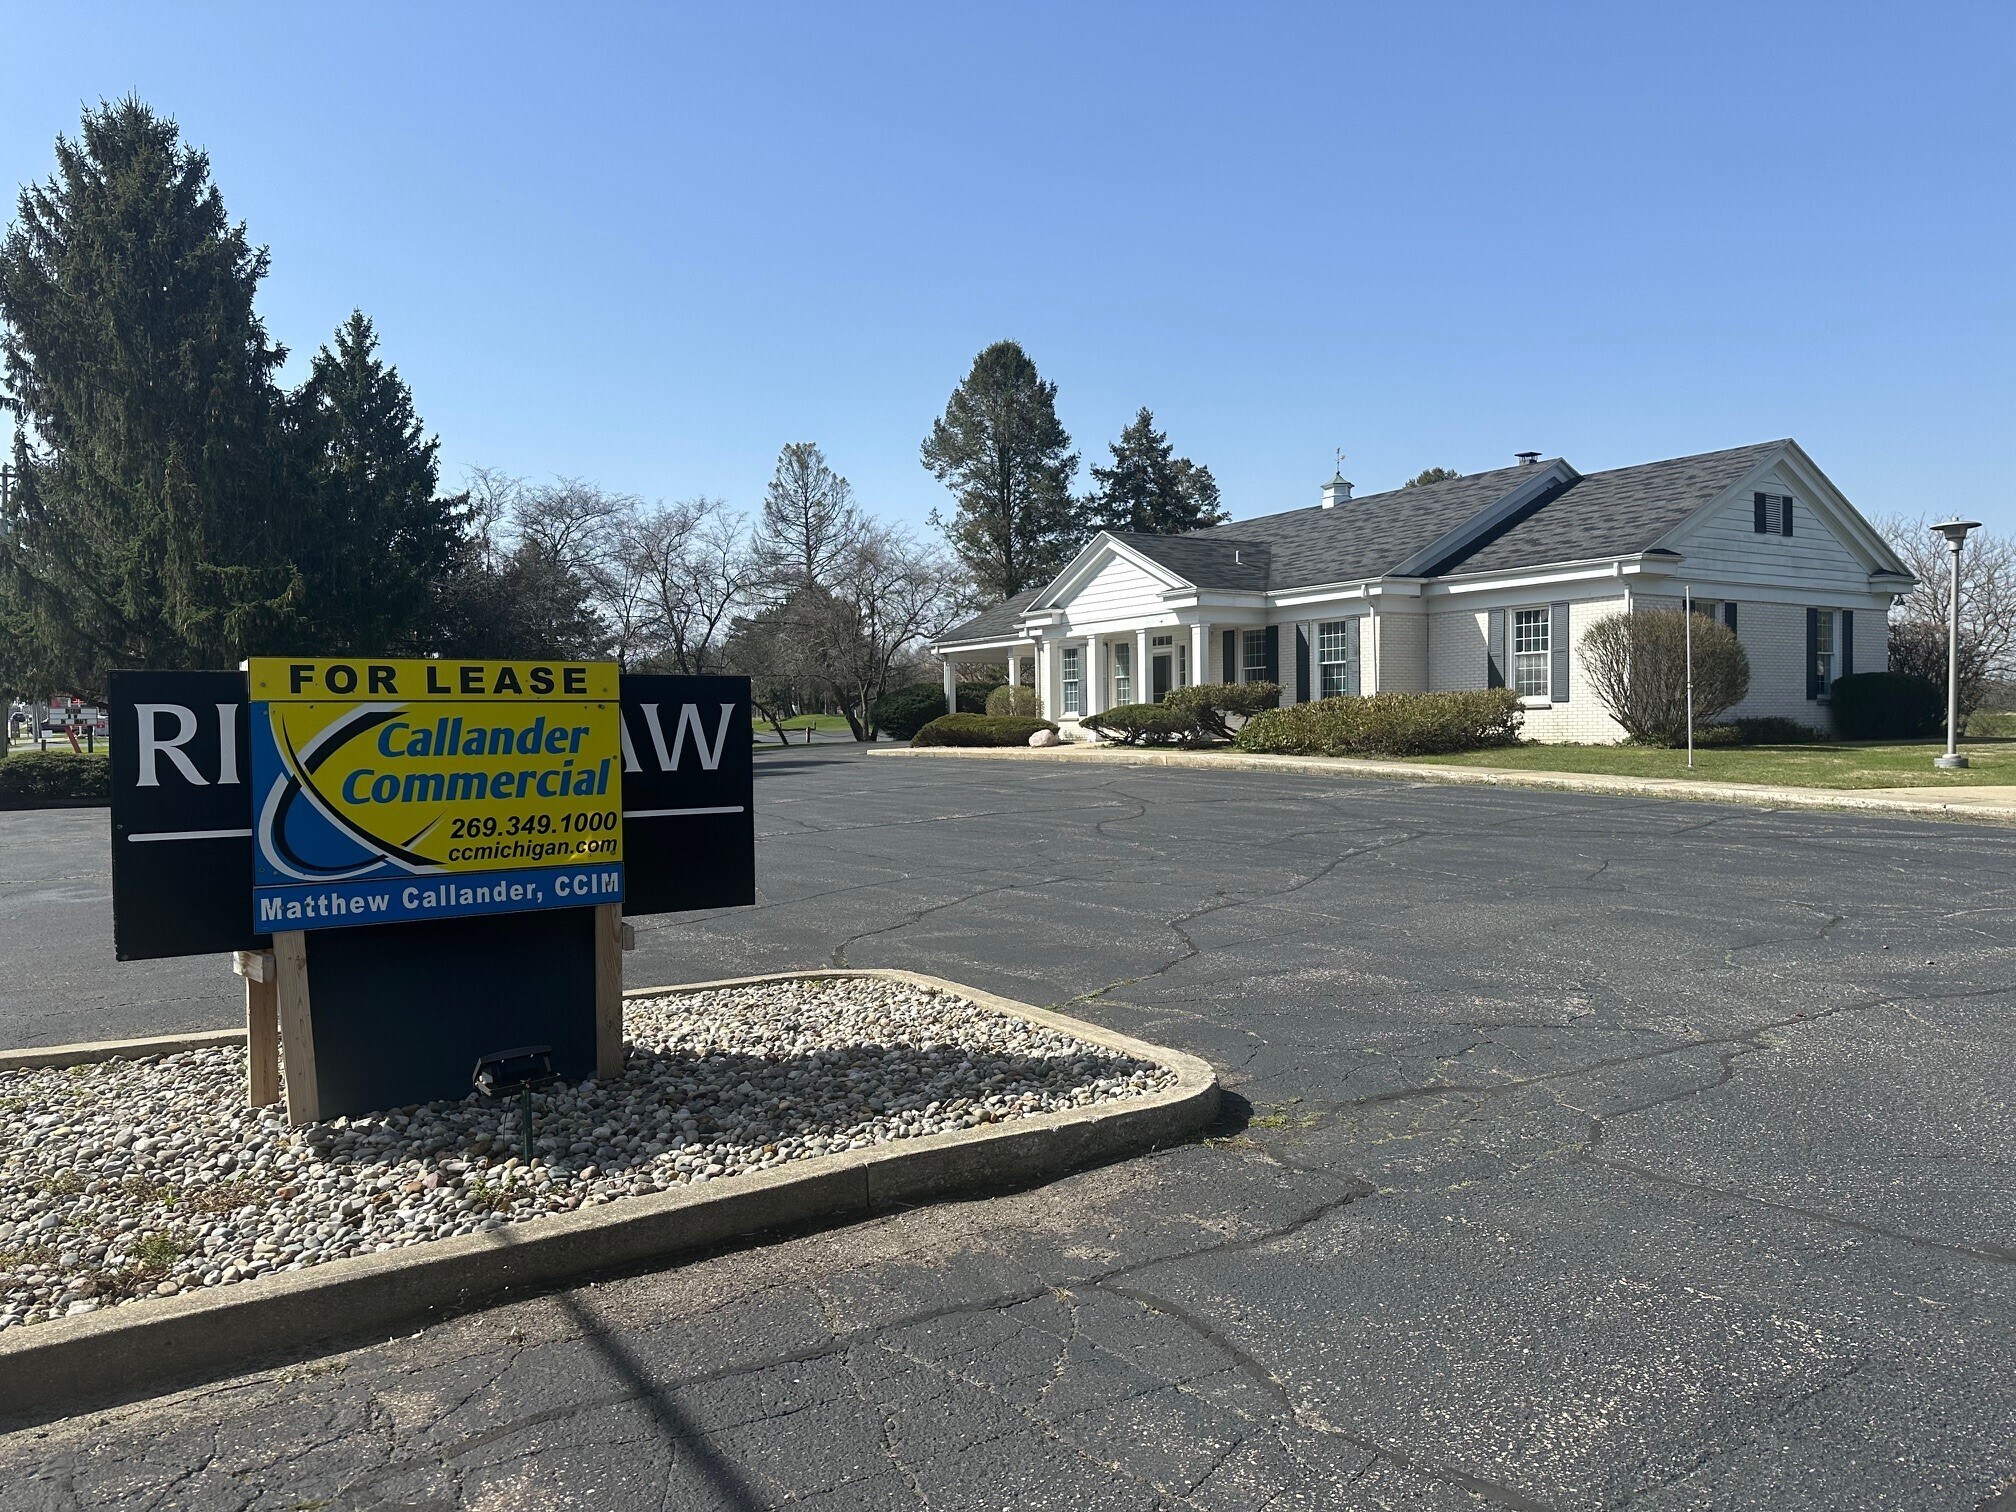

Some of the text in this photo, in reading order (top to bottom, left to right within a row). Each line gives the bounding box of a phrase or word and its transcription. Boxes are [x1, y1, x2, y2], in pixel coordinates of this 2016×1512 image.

[289, 664, 588, 695] FOR LEASE
[377, 716, 590, 758] Callander
[341, 758, 612, 805] Commercial
[450, 811, 618, 840] 269.349.1000
[448, 838, 618, 862] ccmichigan.com
[260, 872, 619, 922] Matthew Callander, CCIM
